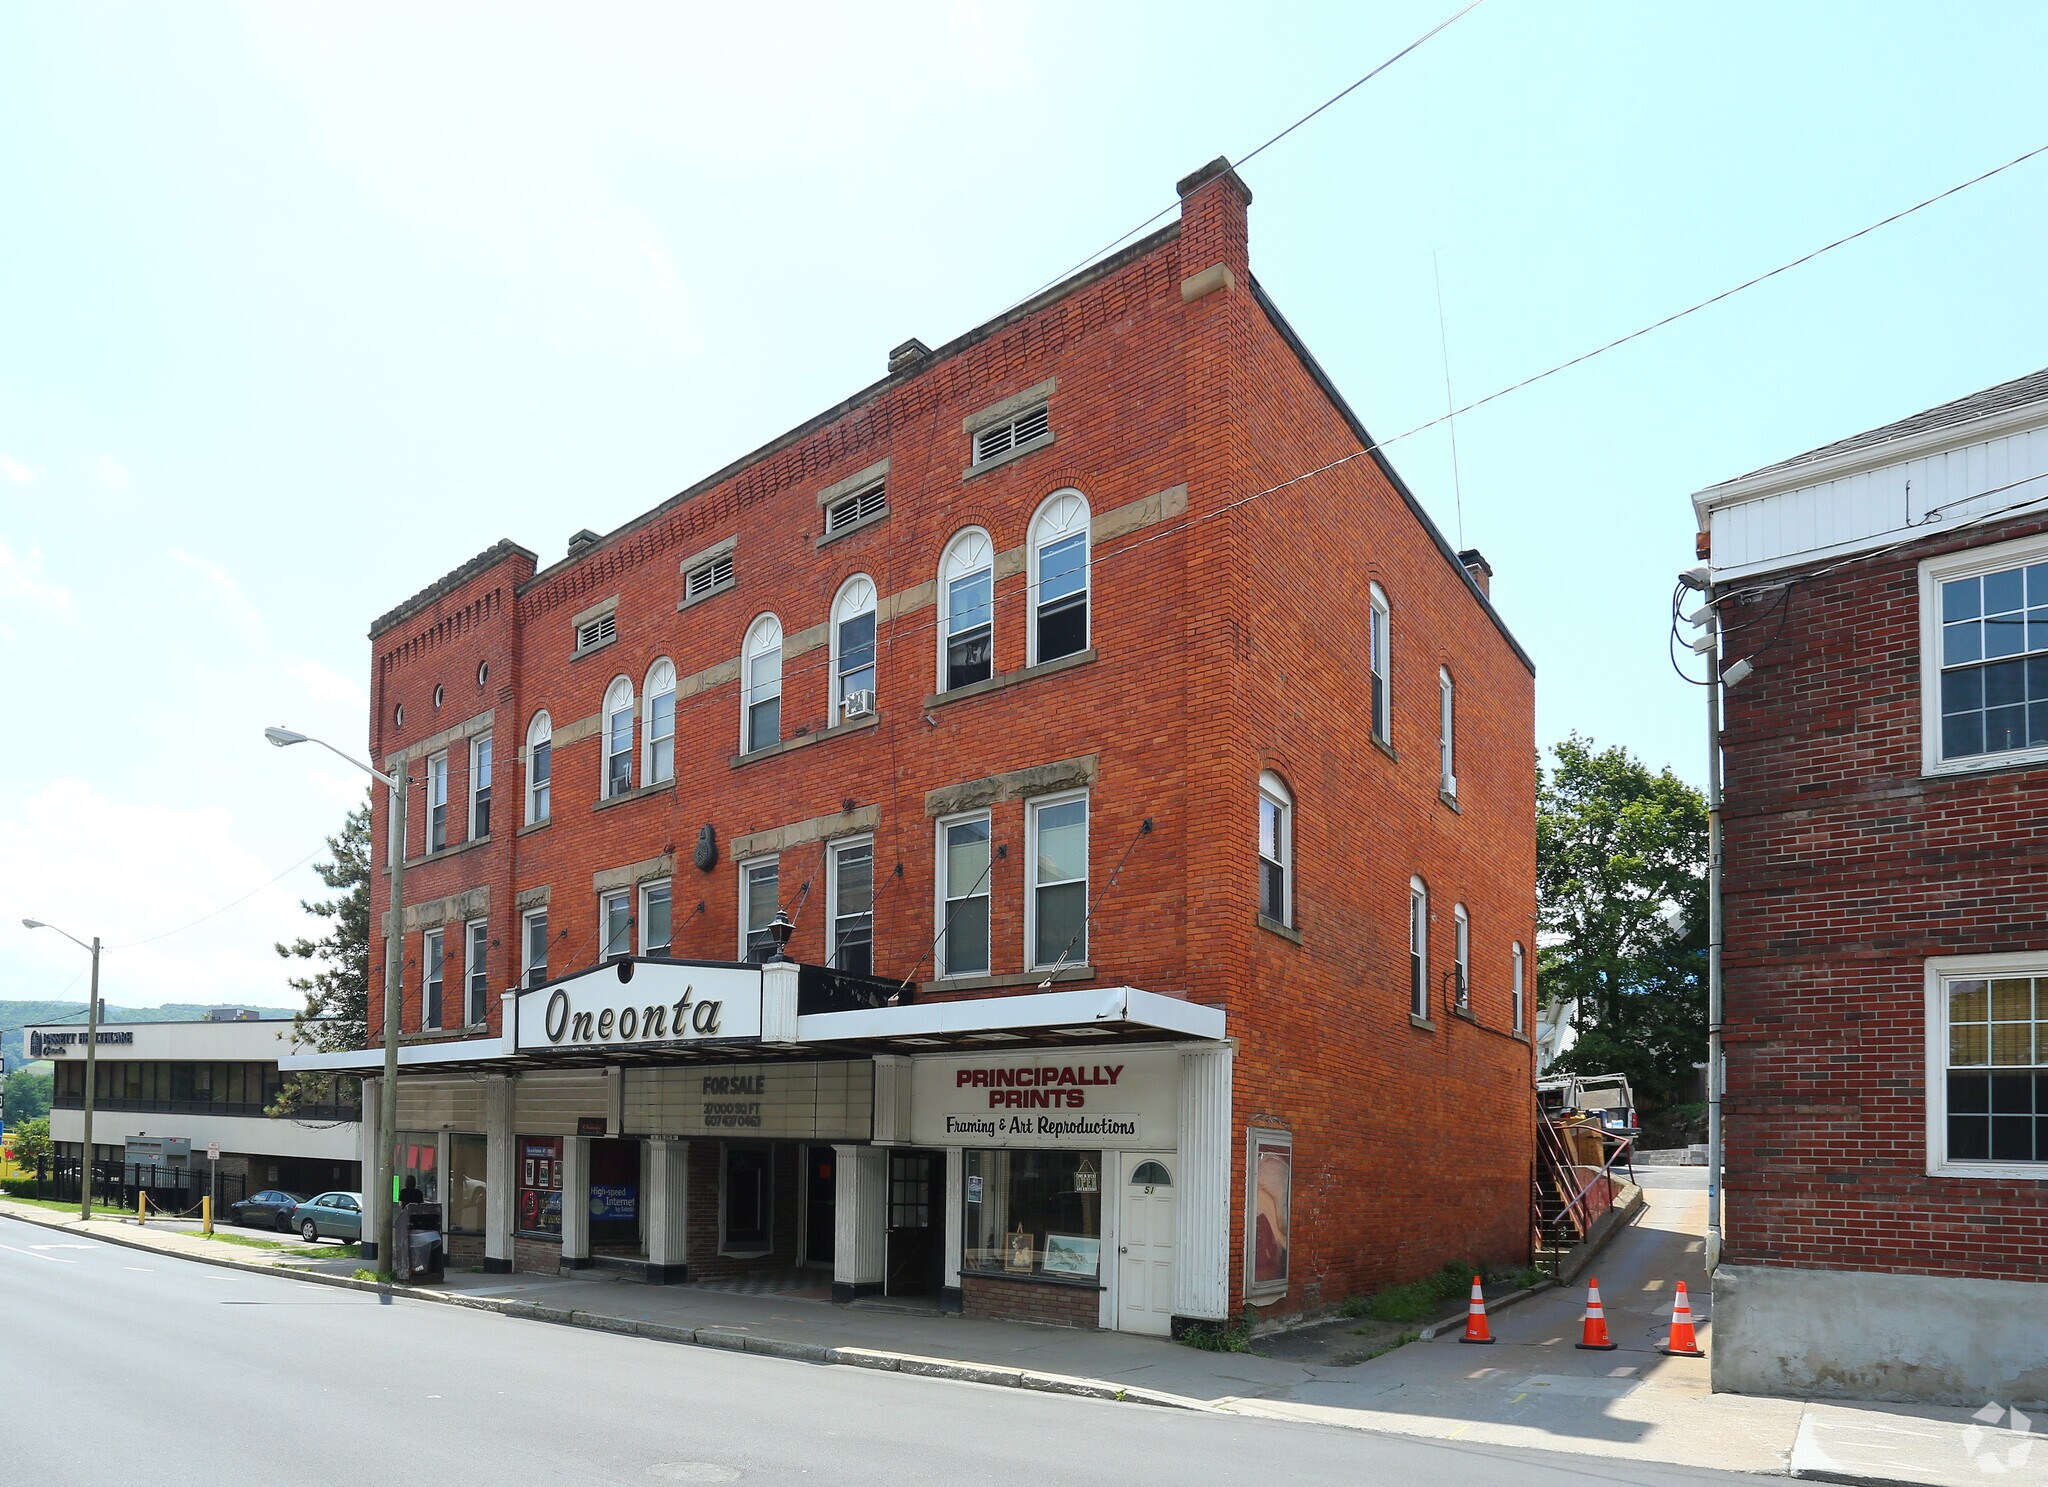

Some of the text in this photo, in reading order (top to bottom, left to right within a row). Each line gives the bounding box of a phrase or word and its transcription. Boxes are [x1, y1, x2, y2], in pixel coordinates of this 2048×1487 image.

[545, 984, 723, 1044] Oneonta
[43, 1033, 77, 1045] BASSETT
[956, 1065, 1125, 1087] PRINCIPALLY
[703, 1075, 765, 1095] FOR SALE
[989, 1089, 1085, 1108] PRINTS
[704, 1103, 760, 1114] 37000 SQ FT
[705, 1115, 721, 1126] 607
[946, 1116, 1136, 1139] Framing & Art Reproductions
[1076, 1178, 1097, 1188] OPEN
[590, 1186, 626, 1197] High-speed
[1144, 1186, 1154, 1194] 51
[606, 1197, 635, 1206] Internet
